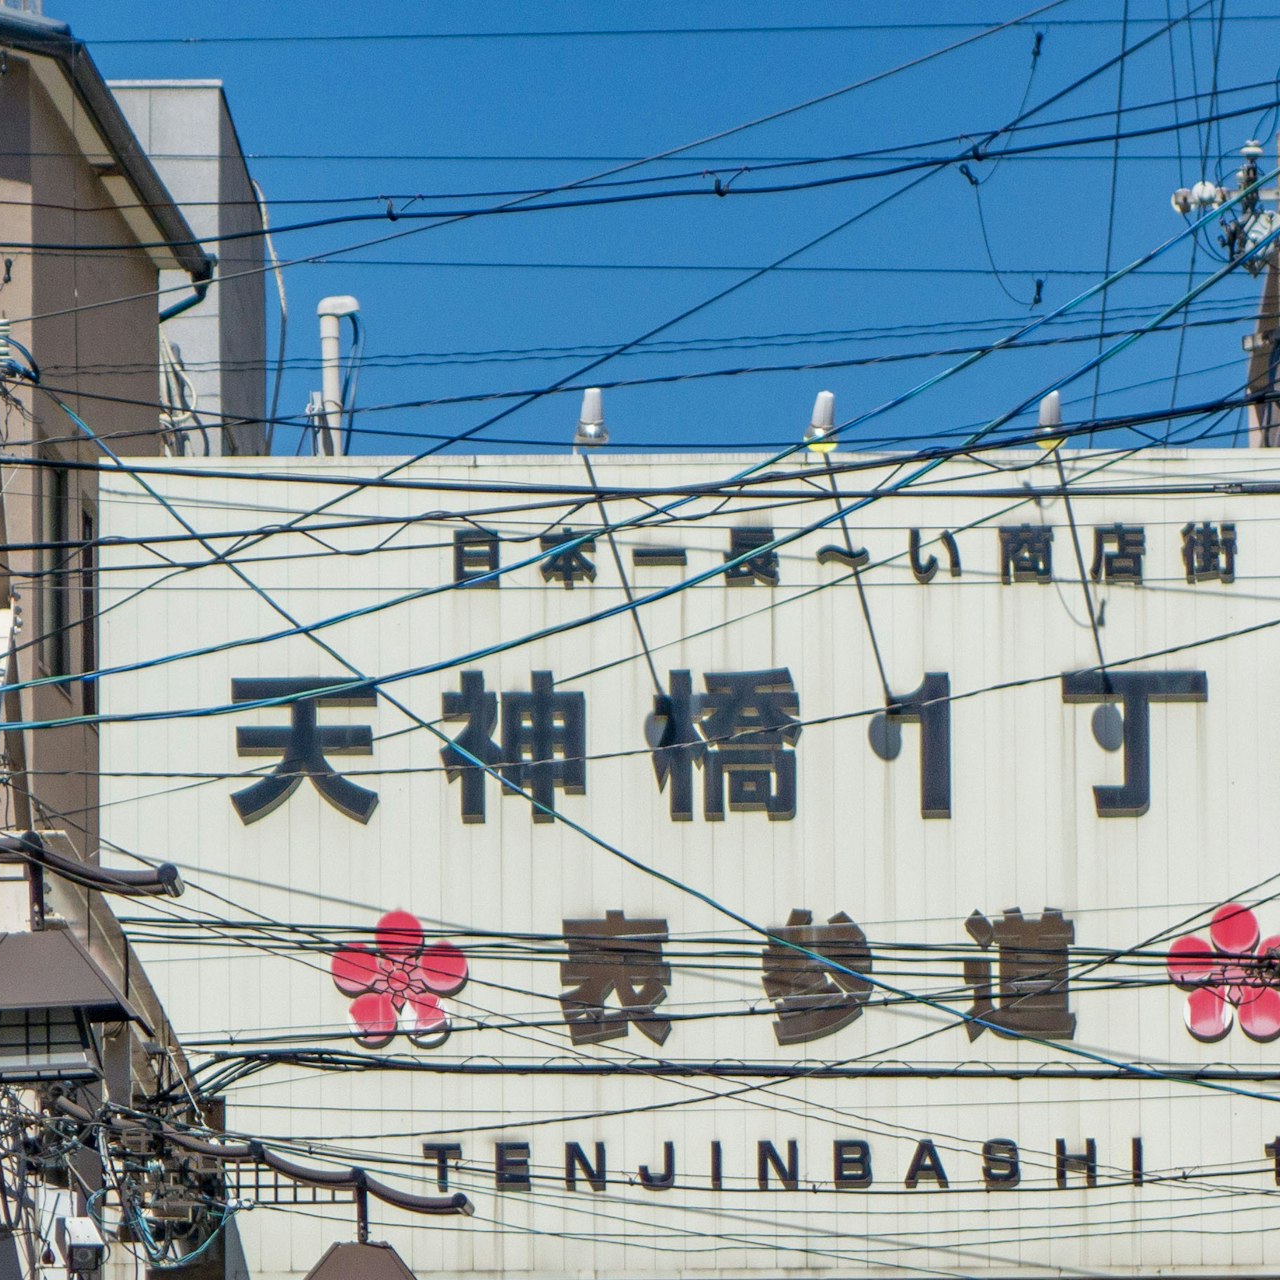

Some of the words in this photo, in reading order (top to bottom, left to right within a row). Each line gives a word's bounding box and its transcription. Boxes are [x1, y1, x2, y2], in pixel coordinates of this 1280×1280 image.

[558, 906, 1077, 1047] 表参道
[422, 1136, 1144, 1194] TENJINBASHI
